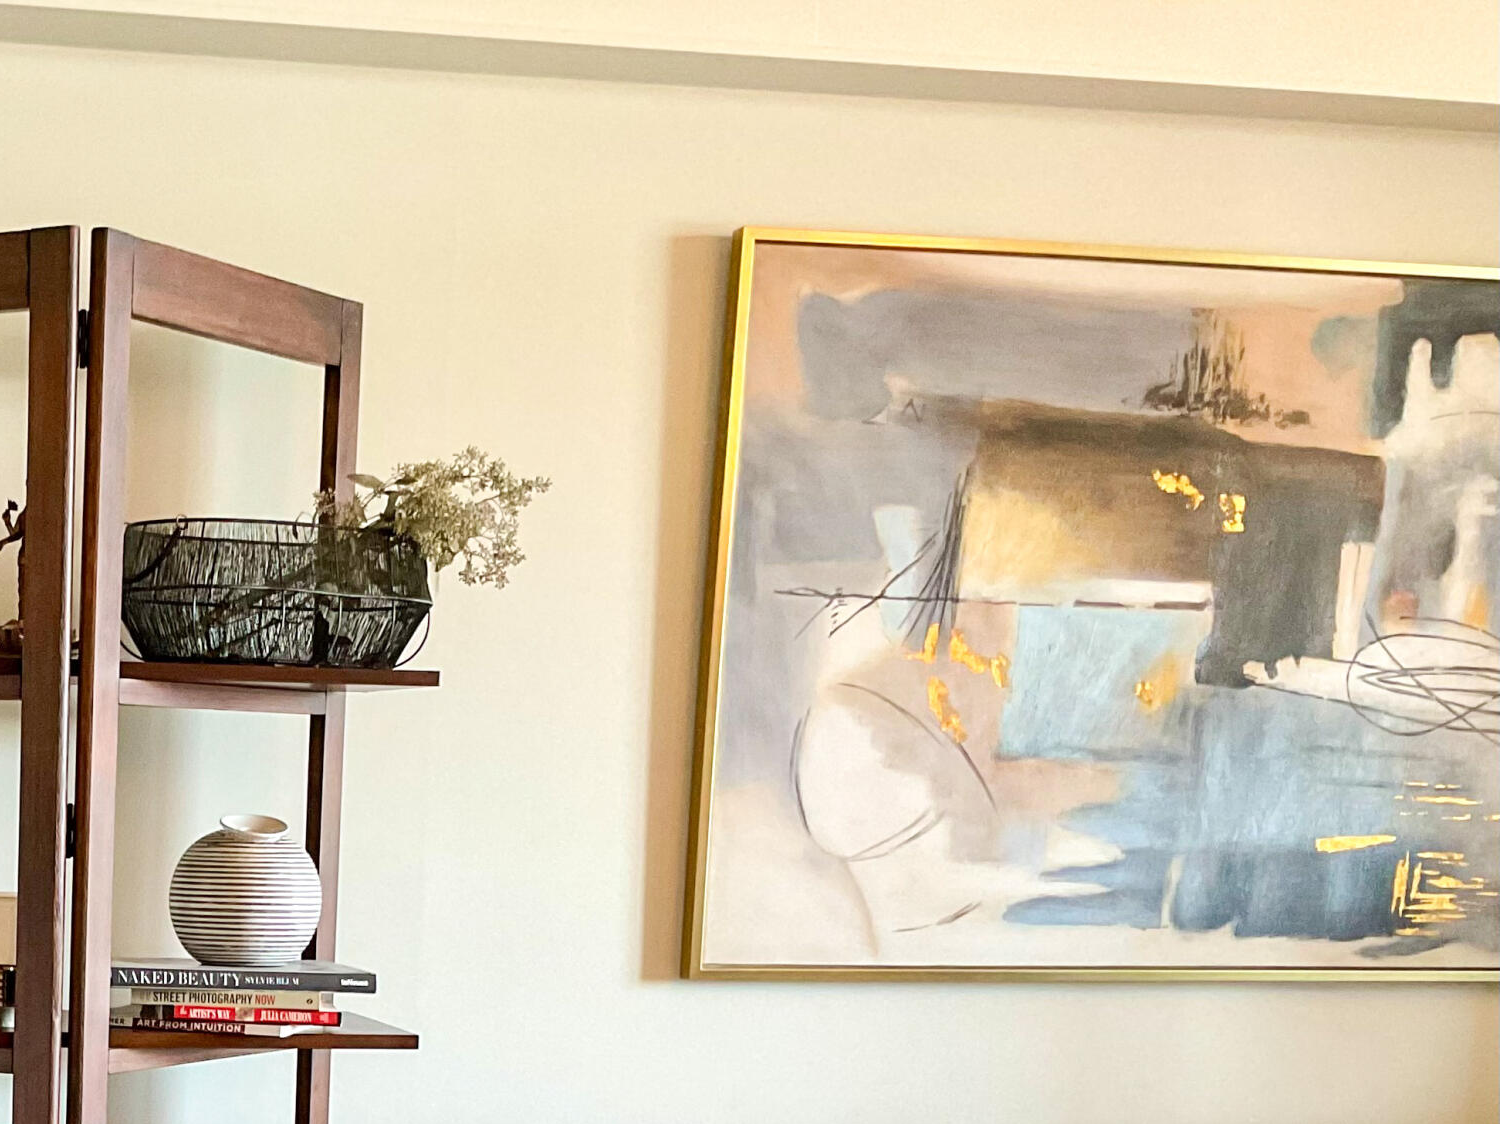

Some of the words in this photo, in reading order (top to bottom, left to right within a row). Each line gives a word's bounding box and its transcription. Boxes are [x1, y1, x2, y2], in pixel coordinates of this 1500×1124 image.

[117, 970, 175, 985] NAKED
[178, 970, 242, 987] BEAUTY
[244, 976, 274, 985] SYLVIE
[153, 991, 187, 1003] STREET
[188, 992, 252, 1006] PHOTOGRAPHY
[255, 994, 276, 1006] NOW
[188, 1008, 215, 1019] ARTIST'S
[217, 1008, 230, 1020] WAY
[260, 1010, 279, 1021] JULIA
[280, 1011, 312, 1022] CAMERON
[136, 1019, 155, 1027] ART
[159, 1020, 187, 1030] FROM
[189, 1021, 242, 1033] INTUITION
